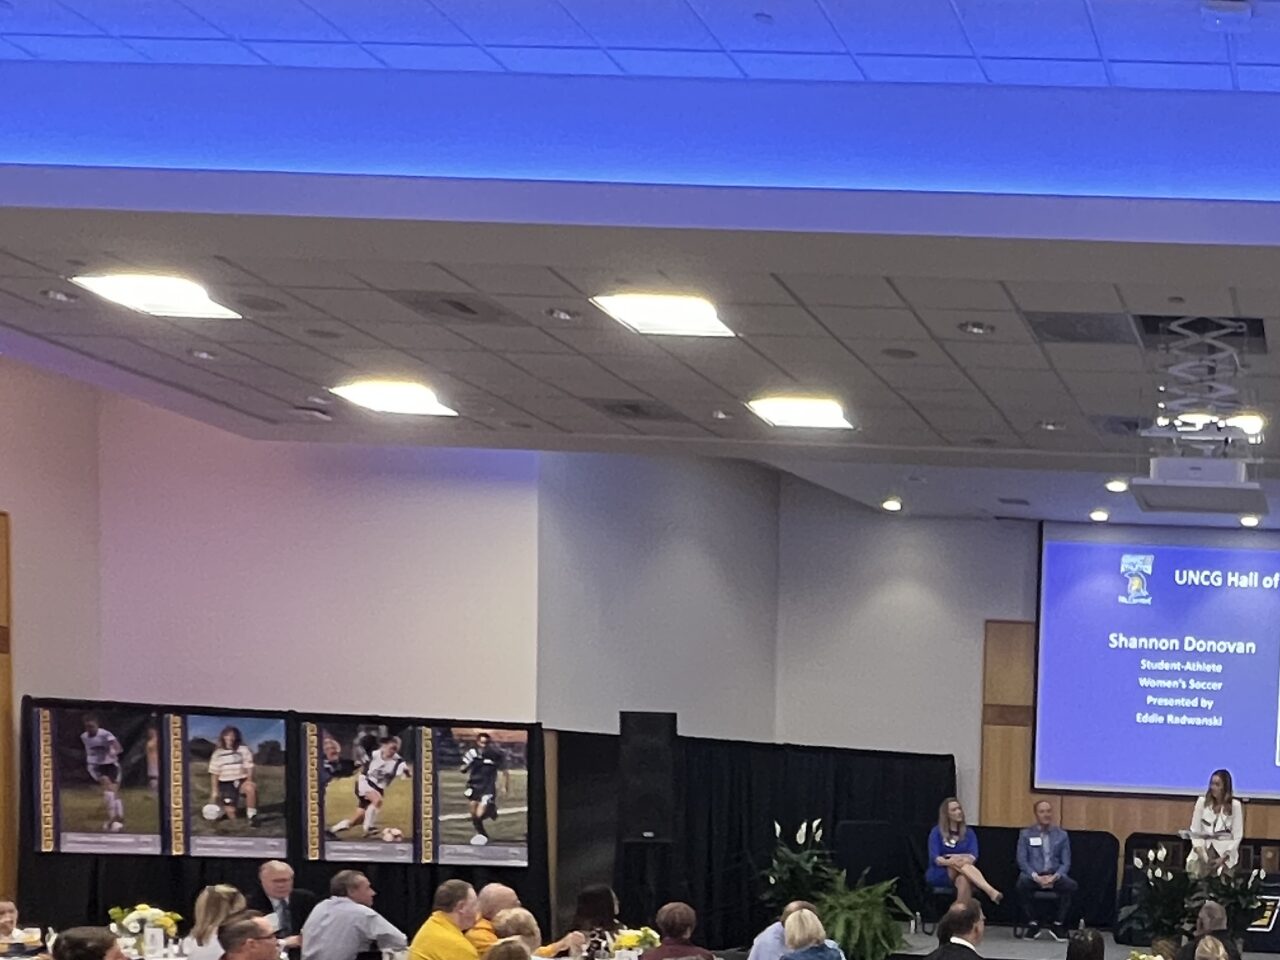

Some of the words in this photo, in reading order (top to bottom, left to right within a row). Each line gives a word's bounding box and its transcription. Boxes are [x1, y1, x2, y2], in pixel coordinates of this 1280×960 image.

[1174, 569, 1223, 587] UNCG
[1227, 571, 1259, 588] Hall
[1262, 572, 1280, 589] of
[1108, 632, 1180, 651] Shannon
[1183, 636, 1256, 654] Donovan
[1140, 658, 1223, 673] Student-Athlete
[1138, 677, 1187, 689] Women's
[1188, 678, 1223, 690] Soccer
[1146, 694, 1199, 707] Presented
[1200, 696, 1214, 710] by
[1135, 712, 1165, 724] Eddie
[1166, 713, 1223, 726] Radwanski
